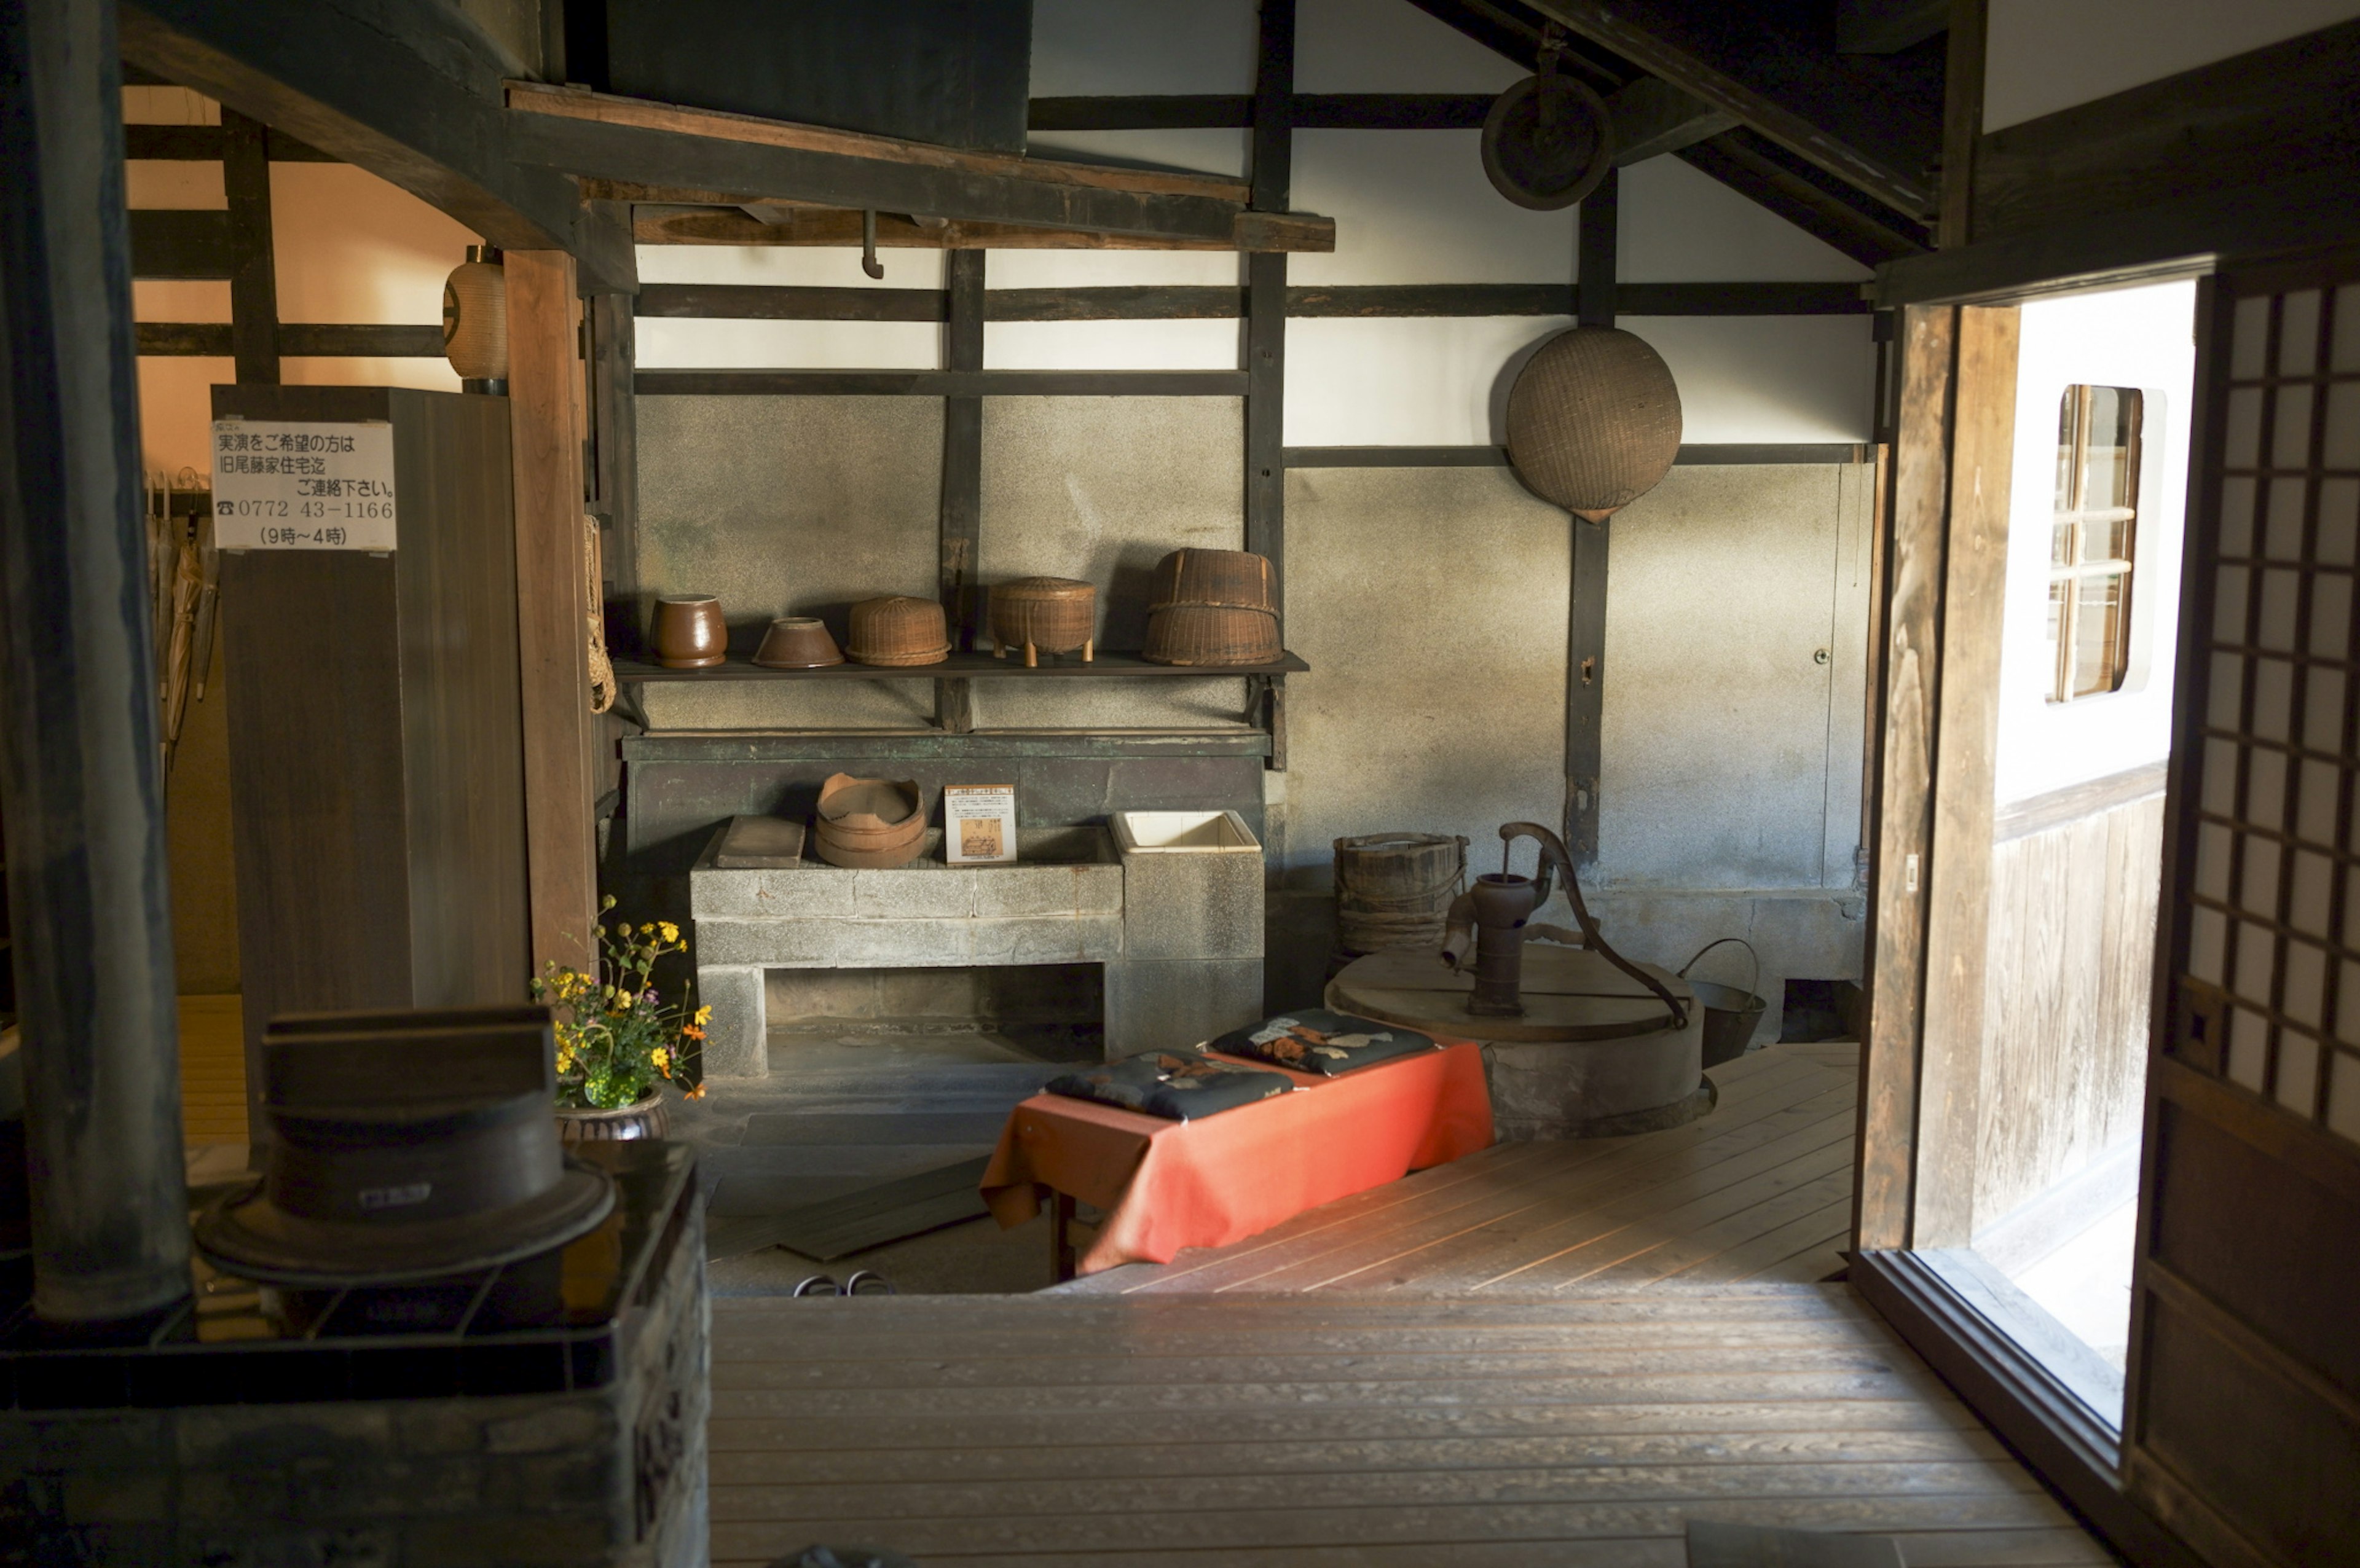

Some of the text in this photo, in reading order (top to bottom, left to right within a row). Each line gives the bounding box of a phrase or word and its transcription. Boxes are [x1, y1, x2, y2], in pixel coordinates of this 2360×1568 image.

[219, 434, 355, 452] 実演をご希望の方は
[220, 456, 325, 474] 旧尾藤家住宅迄
[297, 479, 393, 498] ご連絡下さい。
[239, 500, 393, 519] 0772 43-1166
